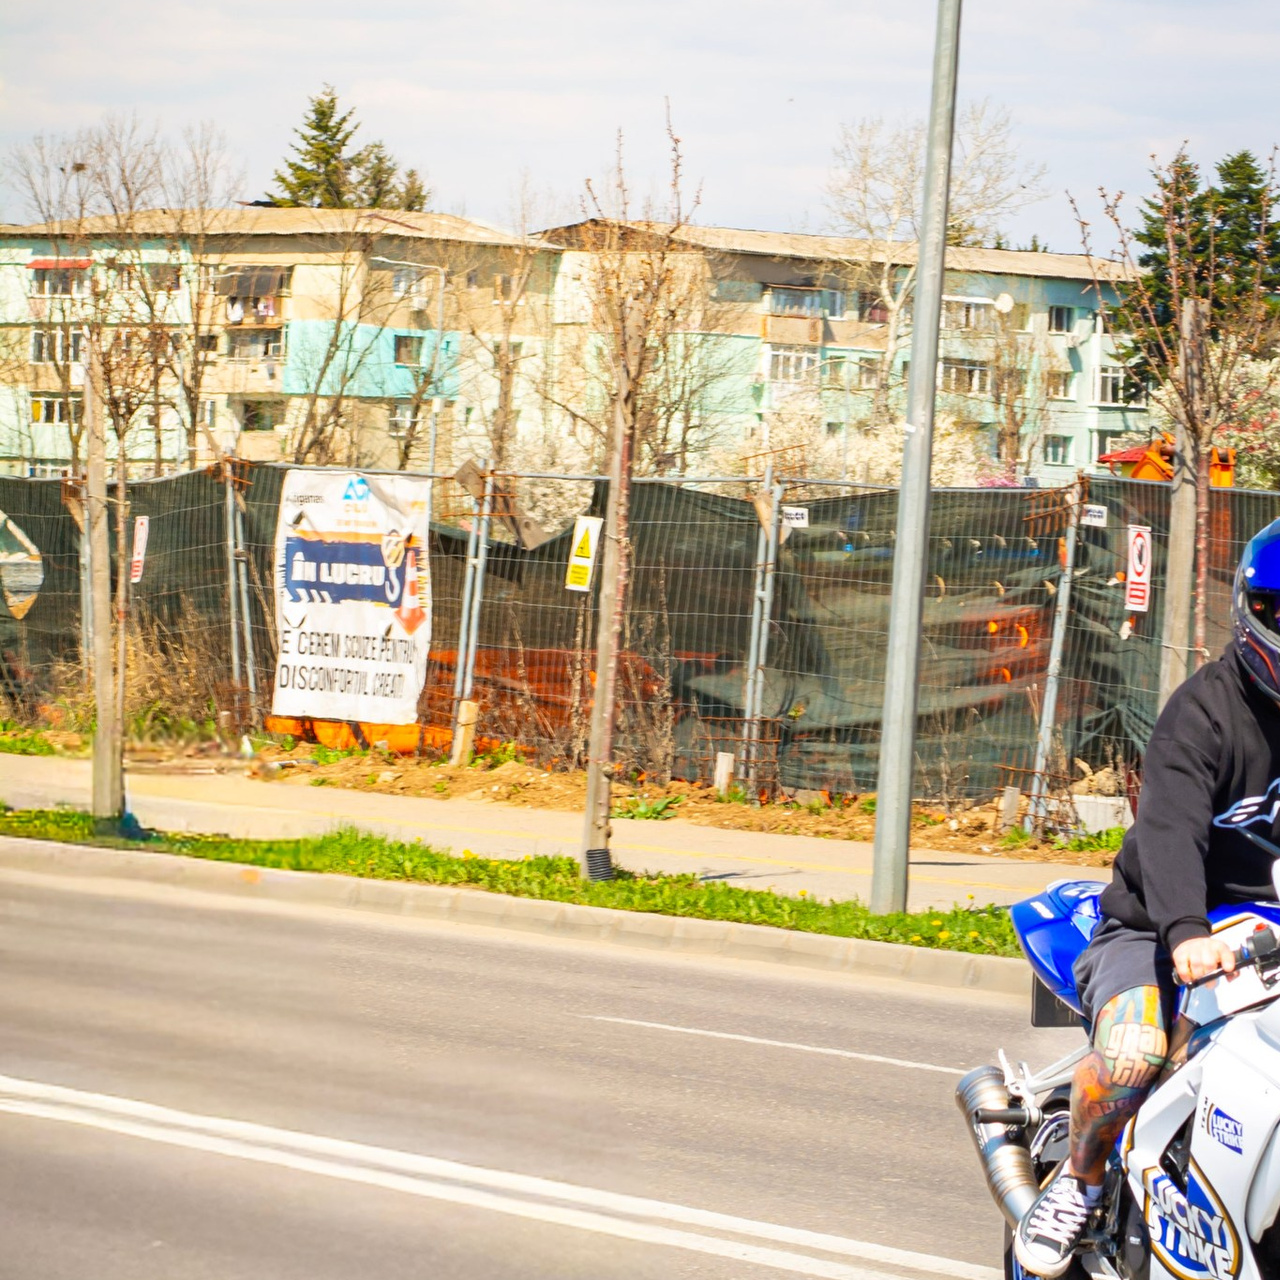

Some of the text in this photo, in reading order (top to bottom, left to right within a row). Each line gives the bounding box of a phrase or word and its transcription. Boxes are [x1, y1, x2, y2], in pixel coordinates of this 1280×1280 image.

[320, 562, 386, 587] LUCRU
[298, 631, 340, 658] CEREM
[1212, 1114, 1243, 1137] LUCKY
[1152, 1179, 1224, 1247] LUCKY
